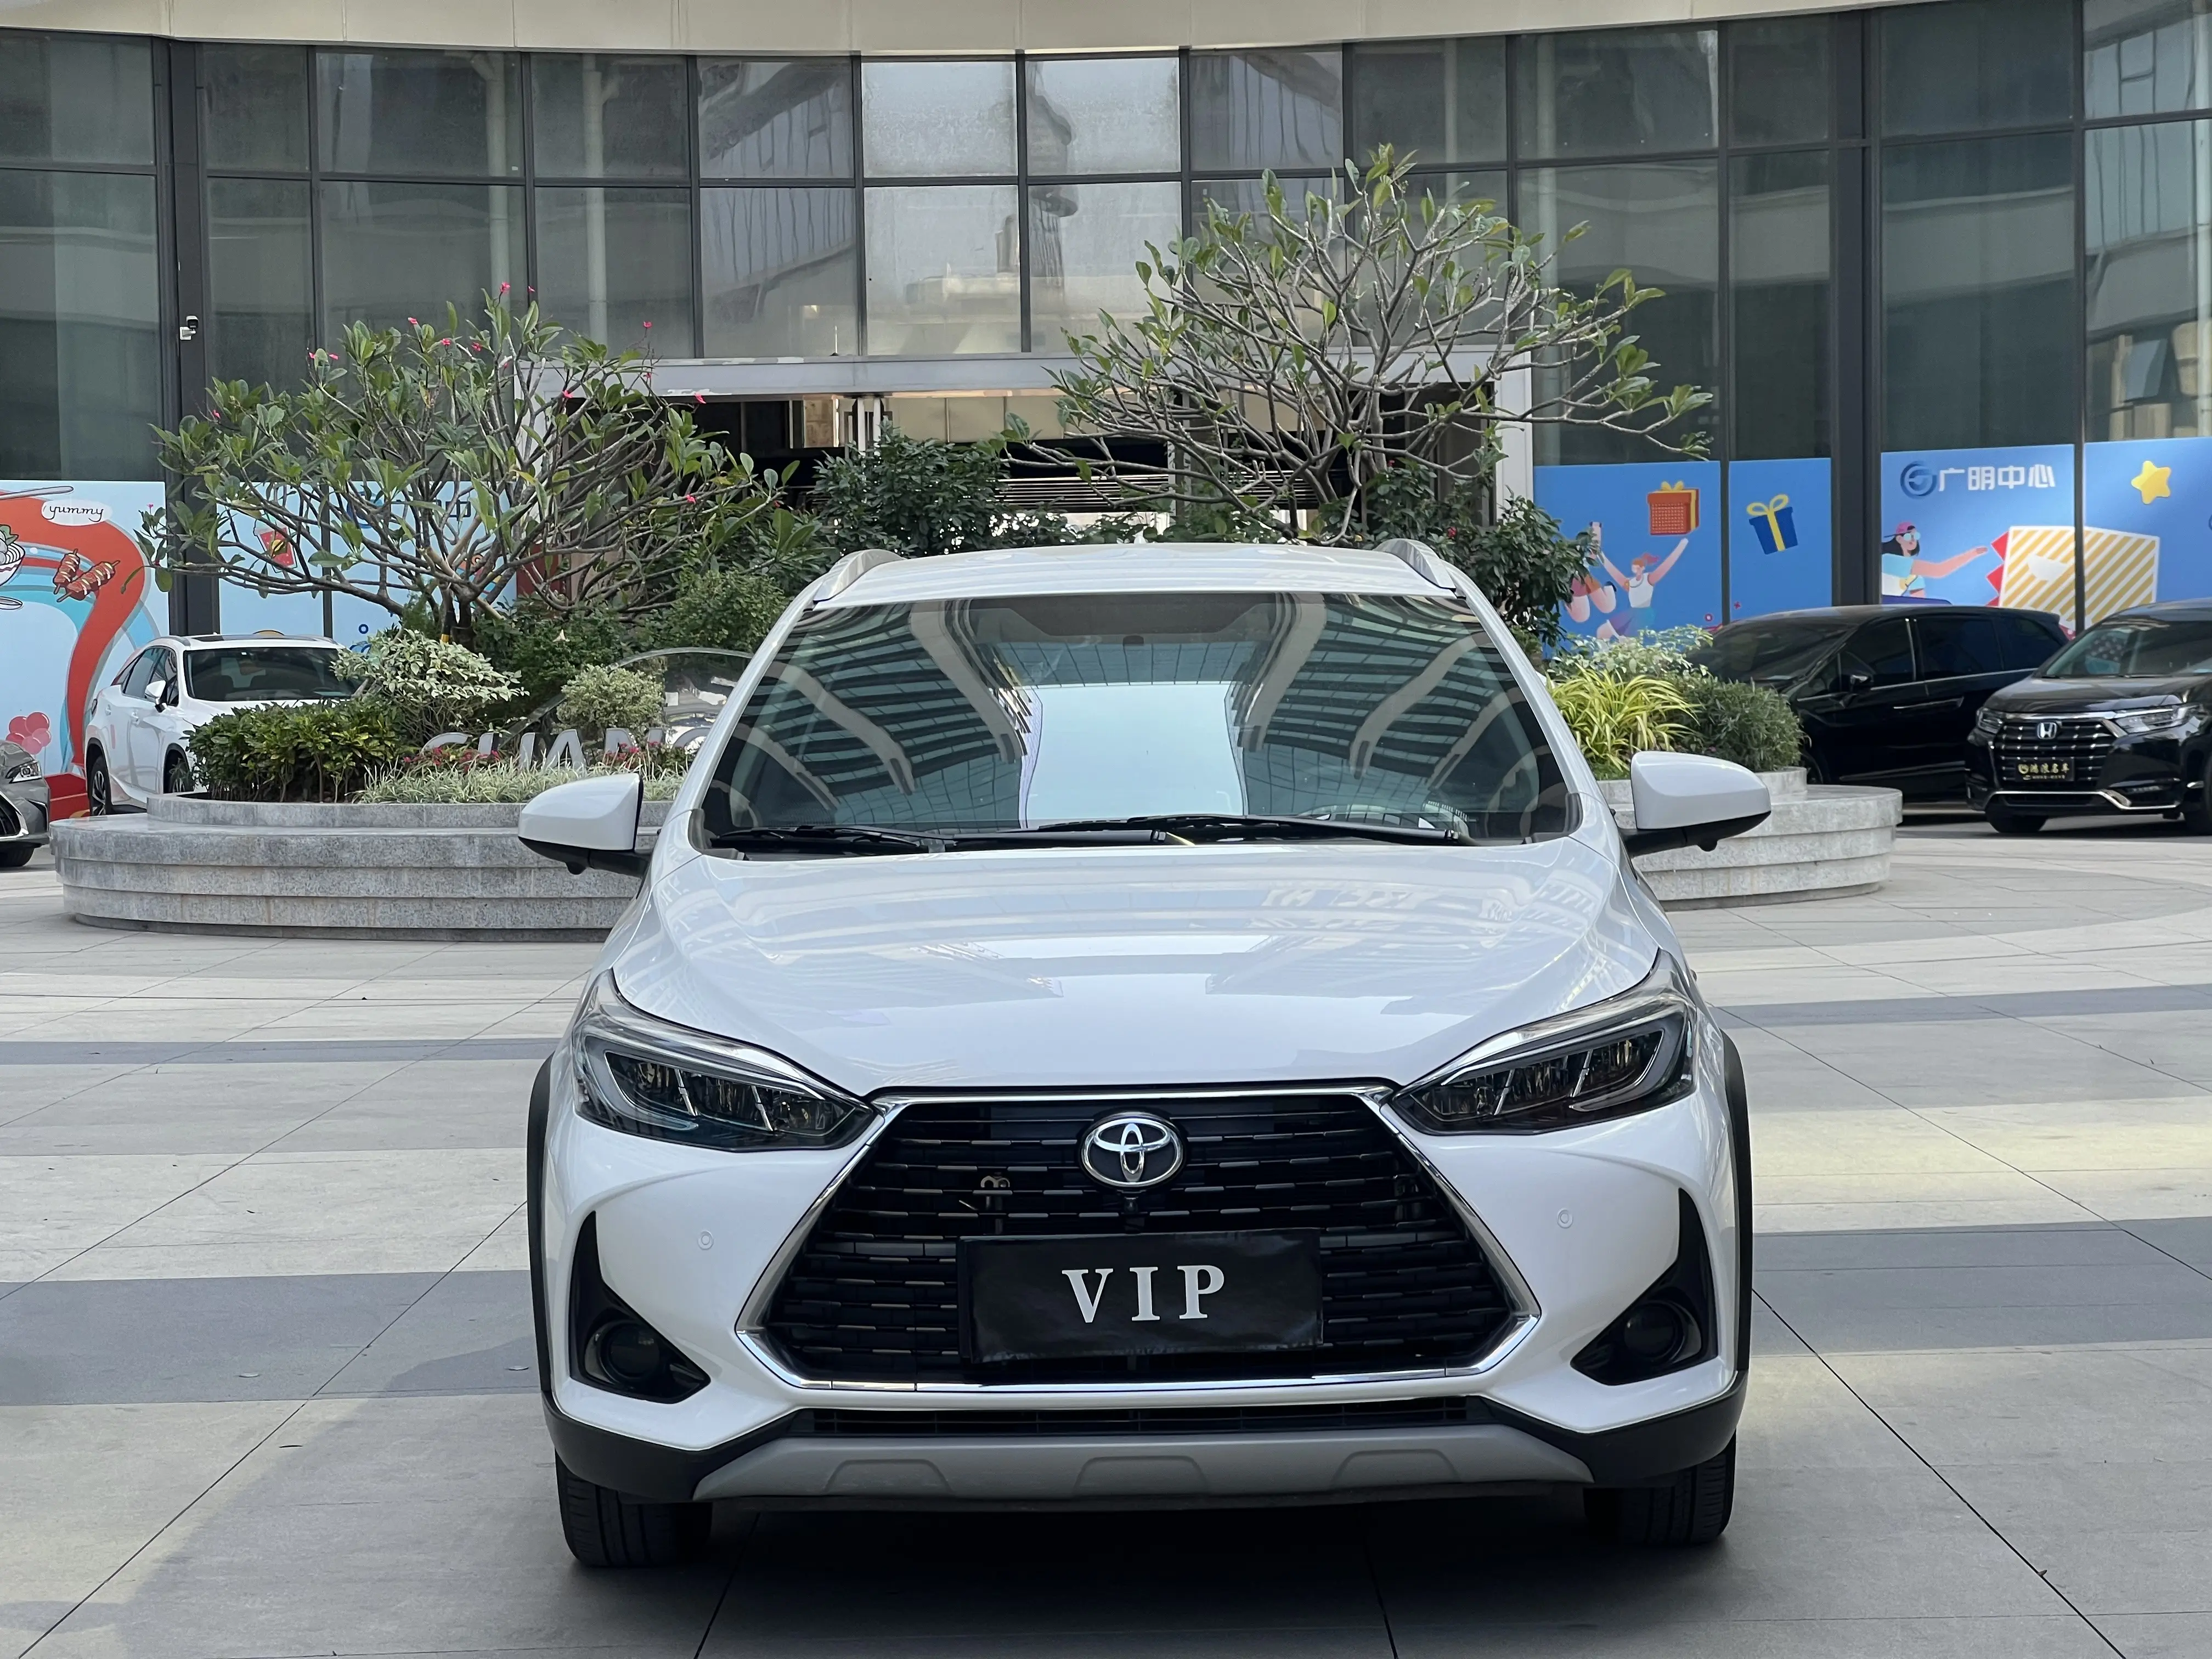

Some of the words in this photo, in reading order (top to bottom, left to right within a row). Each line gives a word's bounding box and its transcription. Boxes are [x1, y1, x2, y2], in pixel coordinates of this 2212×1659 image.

[1939, 464, 2056, 492] 广明中心
[43, 505, 104, 522] yummy
[1062, 1265, 1225, 1324] VIP
